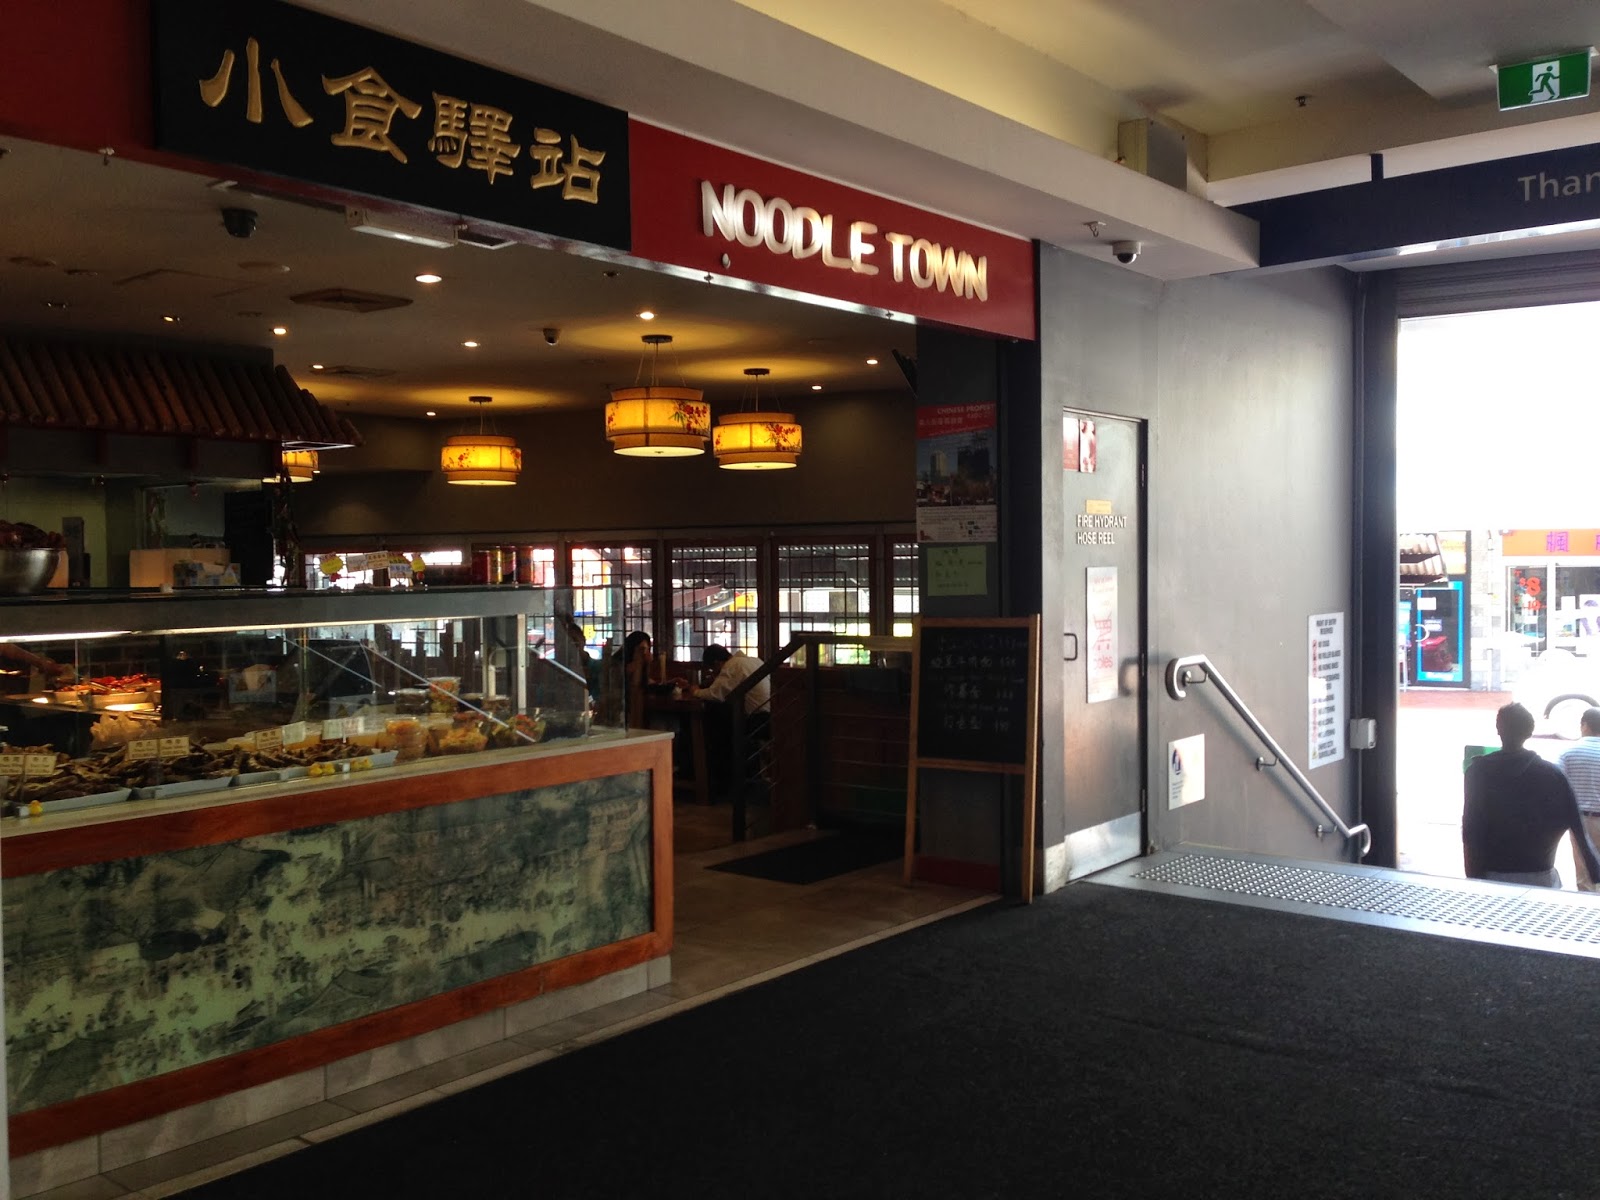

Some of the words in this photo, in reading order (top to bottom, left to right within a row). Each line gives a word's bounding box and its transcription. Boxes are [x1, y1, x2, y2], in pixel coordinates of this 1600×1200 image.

[200, 38, 606, 205] 小食驛站
[701, 180, 879, 276] NOODLE
[885, 232, 988, 302] TOWN
[1076, 514, 1093, 528] FIRE
[1094, 515, 1127, 528] HYDRANT
[1076, 531, 1097, 545] HOSE
[1098, 531, 1115, 545] REEL
